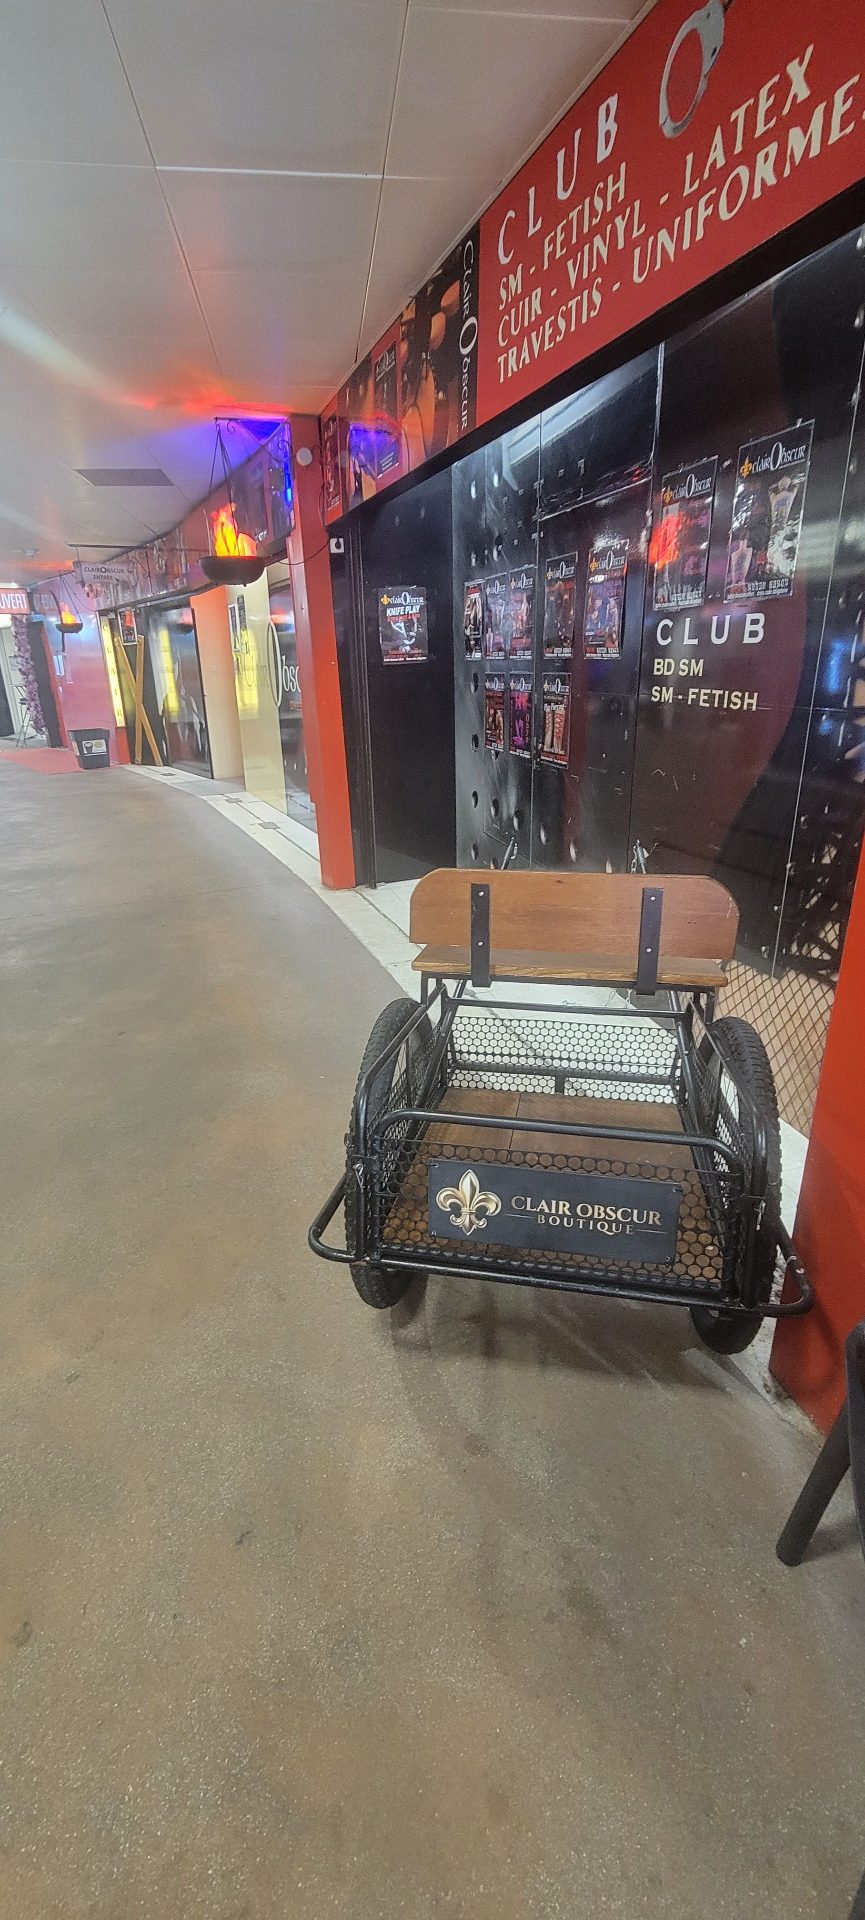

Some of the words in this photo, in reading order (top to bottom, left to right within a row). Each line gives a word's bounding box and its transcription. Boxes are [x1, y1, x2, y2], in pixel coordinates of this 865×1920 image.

[498, 93, 619, 265] CLUB
[498, 287, 542, 347] CUIR
[567, 200, 646, 290] VINYL
[683, 44, 815, 197] LATEX
[498, 277, 602, 383] TRAVESTIS
[632, 74, 865, 285] UNIFORME
[499, 264, 523, 311] SM
[543, 162, 626, 270] FETISH
[387, 606, 404, 617] KNIFE
[405, 605, 420, 614] PLAY
[656, 612, 766, 646] CLUB
[651, 685, 673, 703] SM
[688, 687, 758, 711] FETISH
[511, 1196, 571, 1217] CLAIR
[576, 1203, 662, 1226] OBSCUR
[537, 1214, 634, 1236] BOUTIQUE
